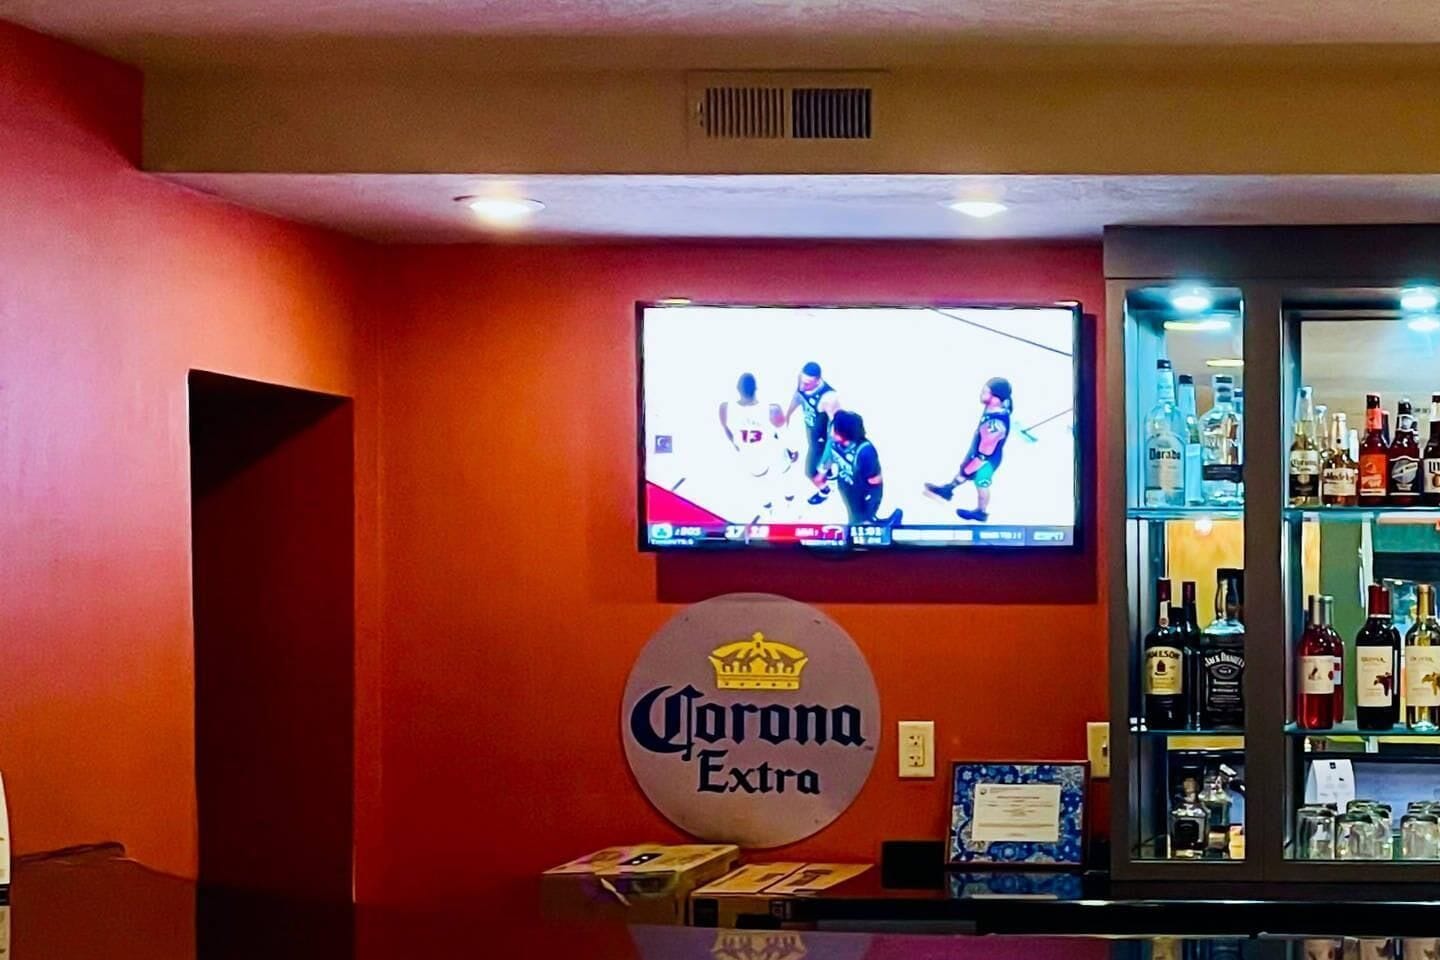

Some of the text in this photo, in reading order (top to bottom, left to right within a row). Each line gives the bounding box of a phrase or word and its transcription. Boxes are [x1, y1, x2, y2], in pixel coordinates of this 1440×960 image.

[740, 429, 763, 443] 13
[631, 684, 867, 761] Corona
[697, 750, 821, 794] Extra
